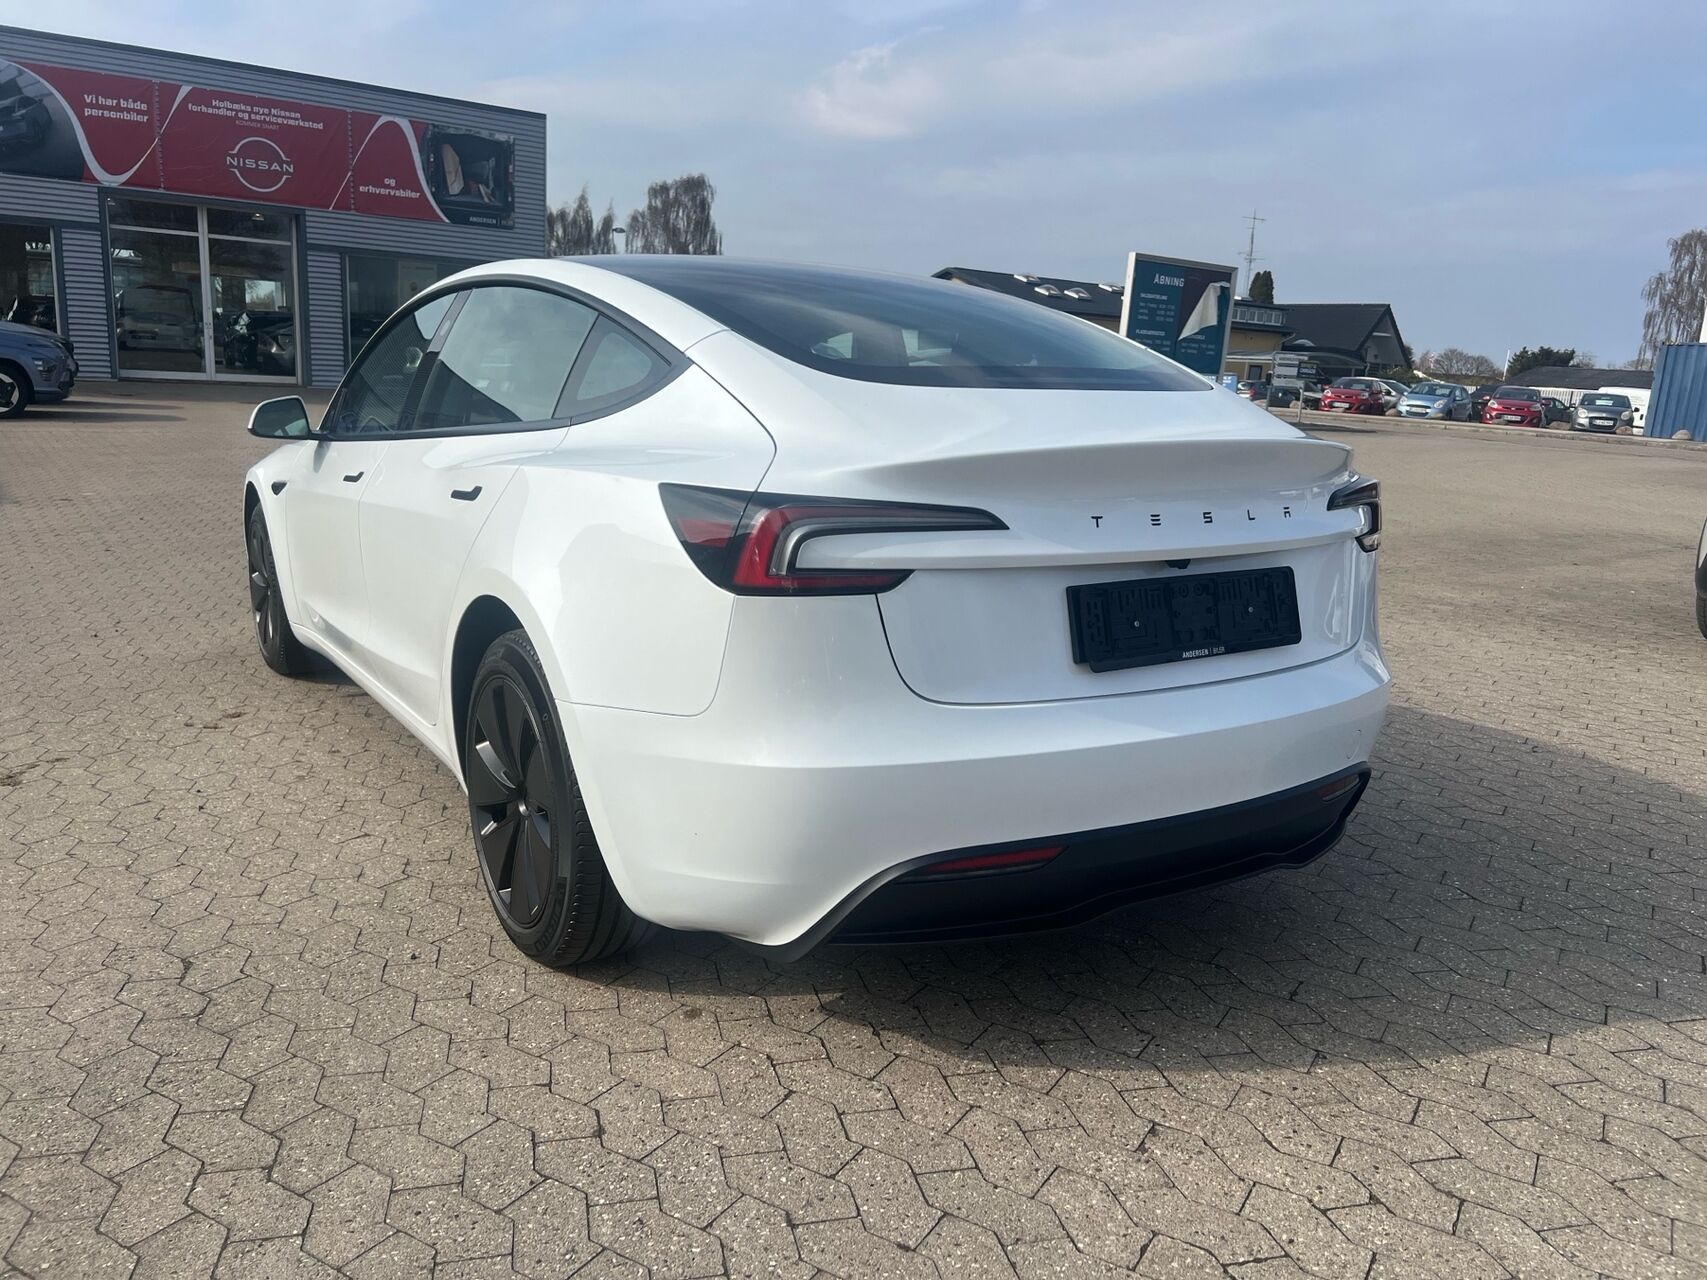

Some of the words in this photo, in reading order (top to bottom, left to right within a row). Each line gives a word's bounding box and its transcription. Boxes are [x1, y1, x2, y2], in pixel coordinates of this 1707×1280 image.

[84, 94, 96, 104] Vi
[98, 96, 118, 107] har
[120, 98, 148, 111] både
[211, 99, 252, 112] Holbæks
[253, 106, 269, 115] nye
[271, 108, 301, 119] Nissan
[84, 108, 149, 122] personbiler
[188, 103, 236, 117] forhandler
[238, 112, 249, 120] og
[251, 113, 324, 130] serviceværksted
[226, 156, 294, 173] NISSAN
[384, 177, 396, 187] og
[359, 185, 421, 199] erhvervsbiler
[469, 216, 497, 225] ANDERSEN
[1091, 506, 1292, 528] TESLA
[1182, 648, 1209, 658] ANDERSEN
